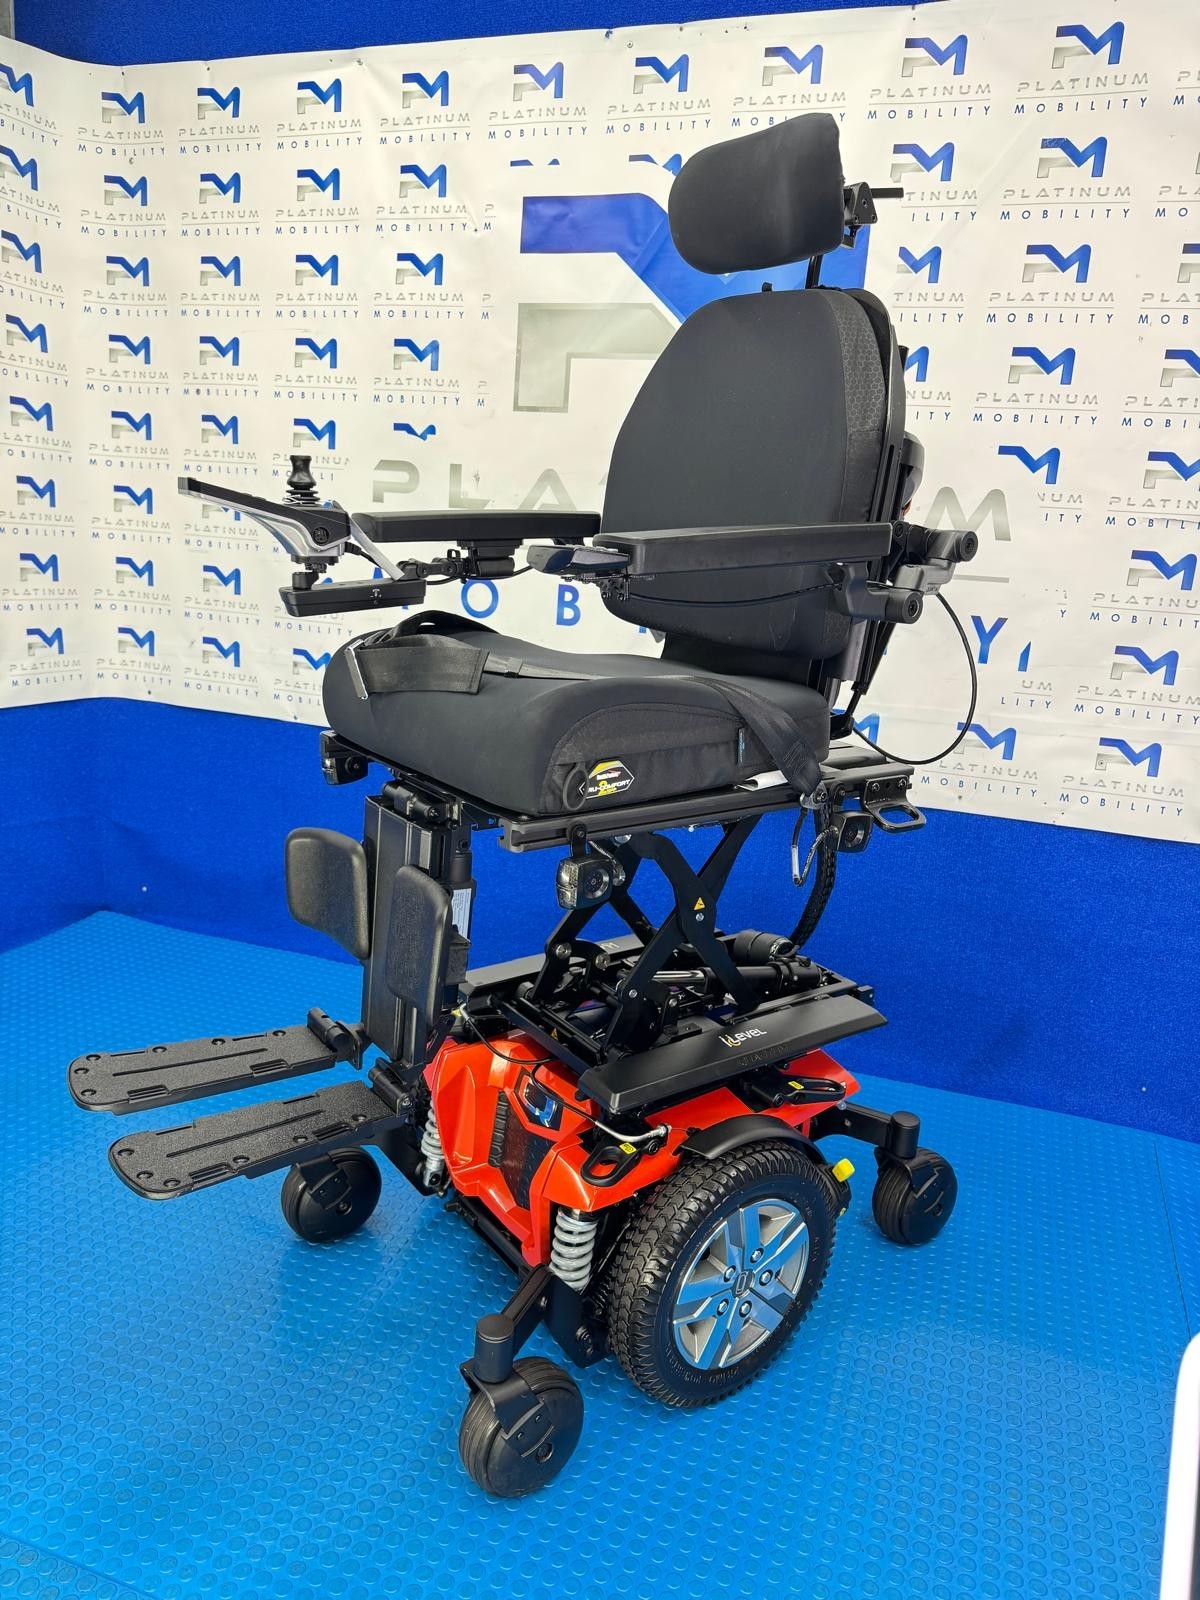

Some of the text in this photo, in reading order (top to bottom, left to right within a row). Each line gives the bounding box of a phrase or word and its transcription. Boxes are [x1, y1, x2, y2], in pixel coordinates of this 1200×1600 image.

[1018, 73, 1148, 92] PLATINUM
[870, 84, 991, 98] PLATINUM
[733, 92, 845, 106] PLATINUM
[1014, 97, 1147, 113] MOBILITY
[608, 98, 710, 114] PLATINUM
[0, 104, 56, 129] TINUM
[489, 107, 586, 120] PLATINUM
[868, 106, 990, 119] MOBILITY
[277, 119, 361, 132] PLATINUM
[380, 113, 470, 127] PLATINUM
[606, 119, 710, 133] MOBILITY
[0, 119, 58, 146] BILITY
[78, 127, 163, 139] PLATINUM
[179, 125, 259, 136] PLATINUM
[488, 127, 587, 139] MOBILITY
[277, 137, 362, 150] MOBILITY
[380, 132, 470, 144] MOBILITY
[78, 143, 164, 156] MOBILITY
[180, 143, 261, 154] MOBILITY
[0, 186, 60, 212] ATINUM
[905, 189, 977, 201] TINUM
[1003, 187, 1130, 199] PLATINUM
[81, 210, 165, 221] PLATINUM
[182, 210, 259, 220] PLATINUM
[276, 207, 358, 217] PLATINUM
[376, 205, 467, 214] PLATINUM
[1000, 209, 1130, 220] MOBILITY
[7, 204, 61, 228] BILITY
[912, 211, 976, 221] ILITY
[81, 226, 166, 237] MOBILITY
[181, 227, 260, 236] MOBILITY
[276, 225, 359, 234] MOBILITY
[376, 223, 467, 232] MOBILITY
[0, 271, 63, 293] ATINUM
[0, 285, 64, 309] OBILITY
[83, 290, 167, 301] PLATINUM
[181, 293, 260, 301] PLATINUM
[276, 293, 357, 301] PLATINUM
[374, 292, 463, 301] PLATINUM
[894, 292, 964, 302] TINUM
[990, 292, 1114, 302] PLATINUM
[84, 306, 167, 317] MOBILITY
[181, 309, 260, 317] MOBILITY
[276, 310, 358, 318] MOBILITY
[374, 310, 464, 319] MOBILITY
[900, 313, 963, 323] ILITY
[987, 313, 1113, 323] MOBILITY
[0, 350, 67, 371] LATINUM
[2, 368, 68, 387] OBILITY
[86, 368, 168, 379] PLATINUM
[183, 372, 258, 381] PLATINUM
[274, 374, 357, 384] PLATINUM
[374, 377, 458, 387] PLATINUM
[87, 383, 169, 394] MOBILITY
[183, 388, 258, 397] MOBILITY
[274, 391, 357, 402] MOBILITY
[374, 394, 460, 405] MOBILITY
[976, 393, 1098, 405] PLATINUM
[1125, 396, 1200, 408] PLATI
[973, 413, 1097, 424] MOBILITY
[1122, 418, 1188, 429] MOBI
[3, 432, 71, 448] LATINUM
[89, 443, 169, 455] PLATINUM
[7, 448, 72, 463] OBILITY
[184, 449, 256, 462] PLATINUM
[89, 459, 170, 470] MOBILITY
[184, 464, 257, 475] MOBILITY
[1109, 497, 1199, 509] PLATIN
[91, 517, 170, 529] PLATINUM
[184, 523, 258, 537] PLATINUM
[92, 532, 171, 544] MOBILITY
[185, 539, 259, 551] MOBILITY
[1, 588, 78, 596] PLATINUM
[94, 589, 170, 602] PLATINUM
[184, 596, 258, 611] PLATINUM
[1093, 593, 1199, 608] PLATINU
[3, 603, 78, 611] MOBILITY
[94, 603, 171, 615] MOBILITY
[184, 611, 260, 625] MOBILITY
[1090, 612, 1199, 628] MOBILIT
[8, 660, 81, 673] PLATINUM
[96, 658, 172, 673] PLATINUM
[12, 674, 82, 687] MOBILITY
[97, 672, 171, 686] MOBILITY
[184, 667, 258, 683] PLATINUM
[184, 682, 259, 697] MOBILITY
[274, 678, 316, 690] PLATI
[274, 694, 320, 706] MOBIL
[1074, 704, 1200, 724] MOBILITY
[939, 760, 1038, 779] LATINUM
[921, 776, 1037, 797] MOBILITY
[1063, 776, 1183, 797] PLATINUM
[1060, 793, 1182, 816] MOBILITY
